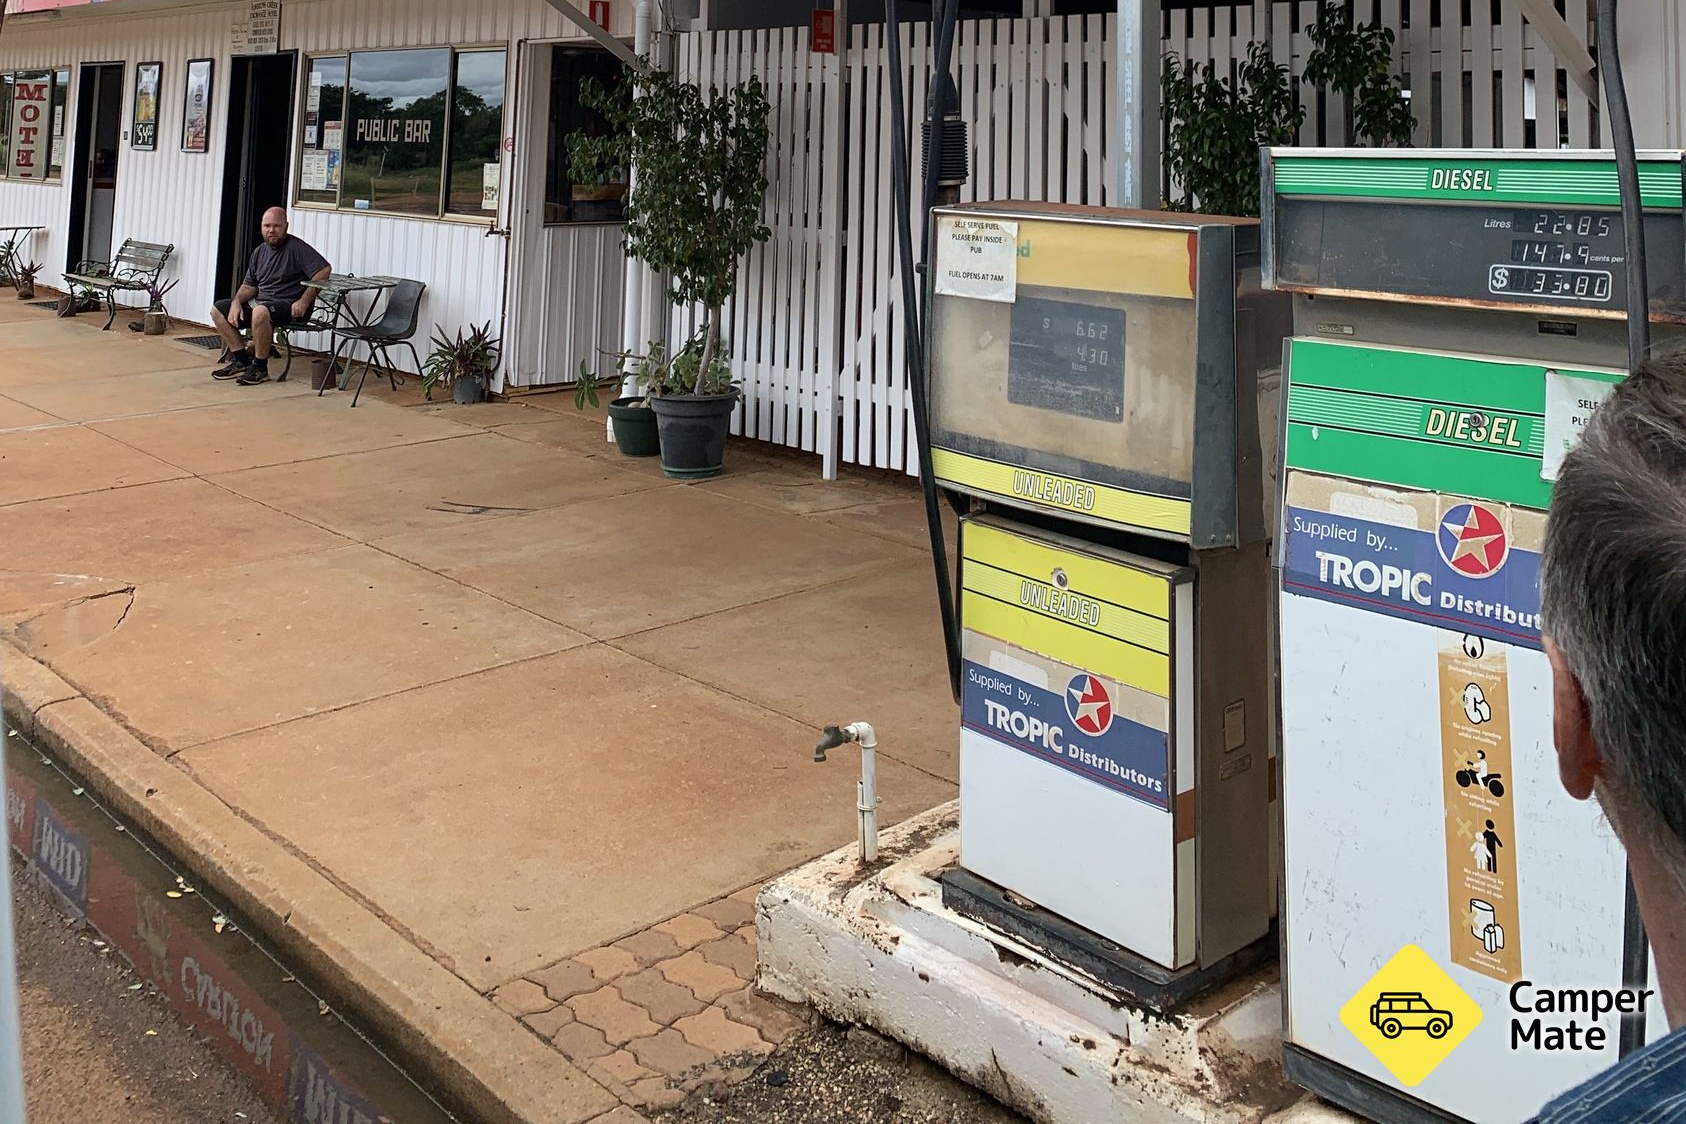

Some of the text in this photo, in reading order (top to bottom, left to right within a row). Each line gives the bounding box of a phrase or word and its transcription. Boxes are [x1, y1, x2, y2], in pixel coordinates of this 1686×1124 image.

[356, 119, 432, 143] PUBLIC BAR
[1431, 168, 1493, 191] DIESEL
[954, 220, 1000, 231] SELF SERVE FUEL
[1484, 218, 1511, 229] Litres
[951, 233, 1002, 244] PLEASE PAY INSIDE
[970, 246, 982, 254] PUB
[1590, 254, 1610, 262] cents
[1611, 256, 1625, 264] per
[949, 270, 1004, 282] FUEL OPENS AT 7AM
[1491, 267, 1509, 289] $
[1578, 399, 1598, 410] SELF
[1425, 408, 1522, 448] DIESEL
[1572, 416, 1588, 426] PLE
[1013, 470, 1095, 511] UNLEADED
[1293, 516, 1356, 543] Supplied
[1315, 550, 1543, 631] TROPIC Distribut
[1020, 580, 1100, 627] UNLEADED
[969, 668, 1012, 696] Supplied
[984, 698, 1162, 792] TROPIC Distributors
